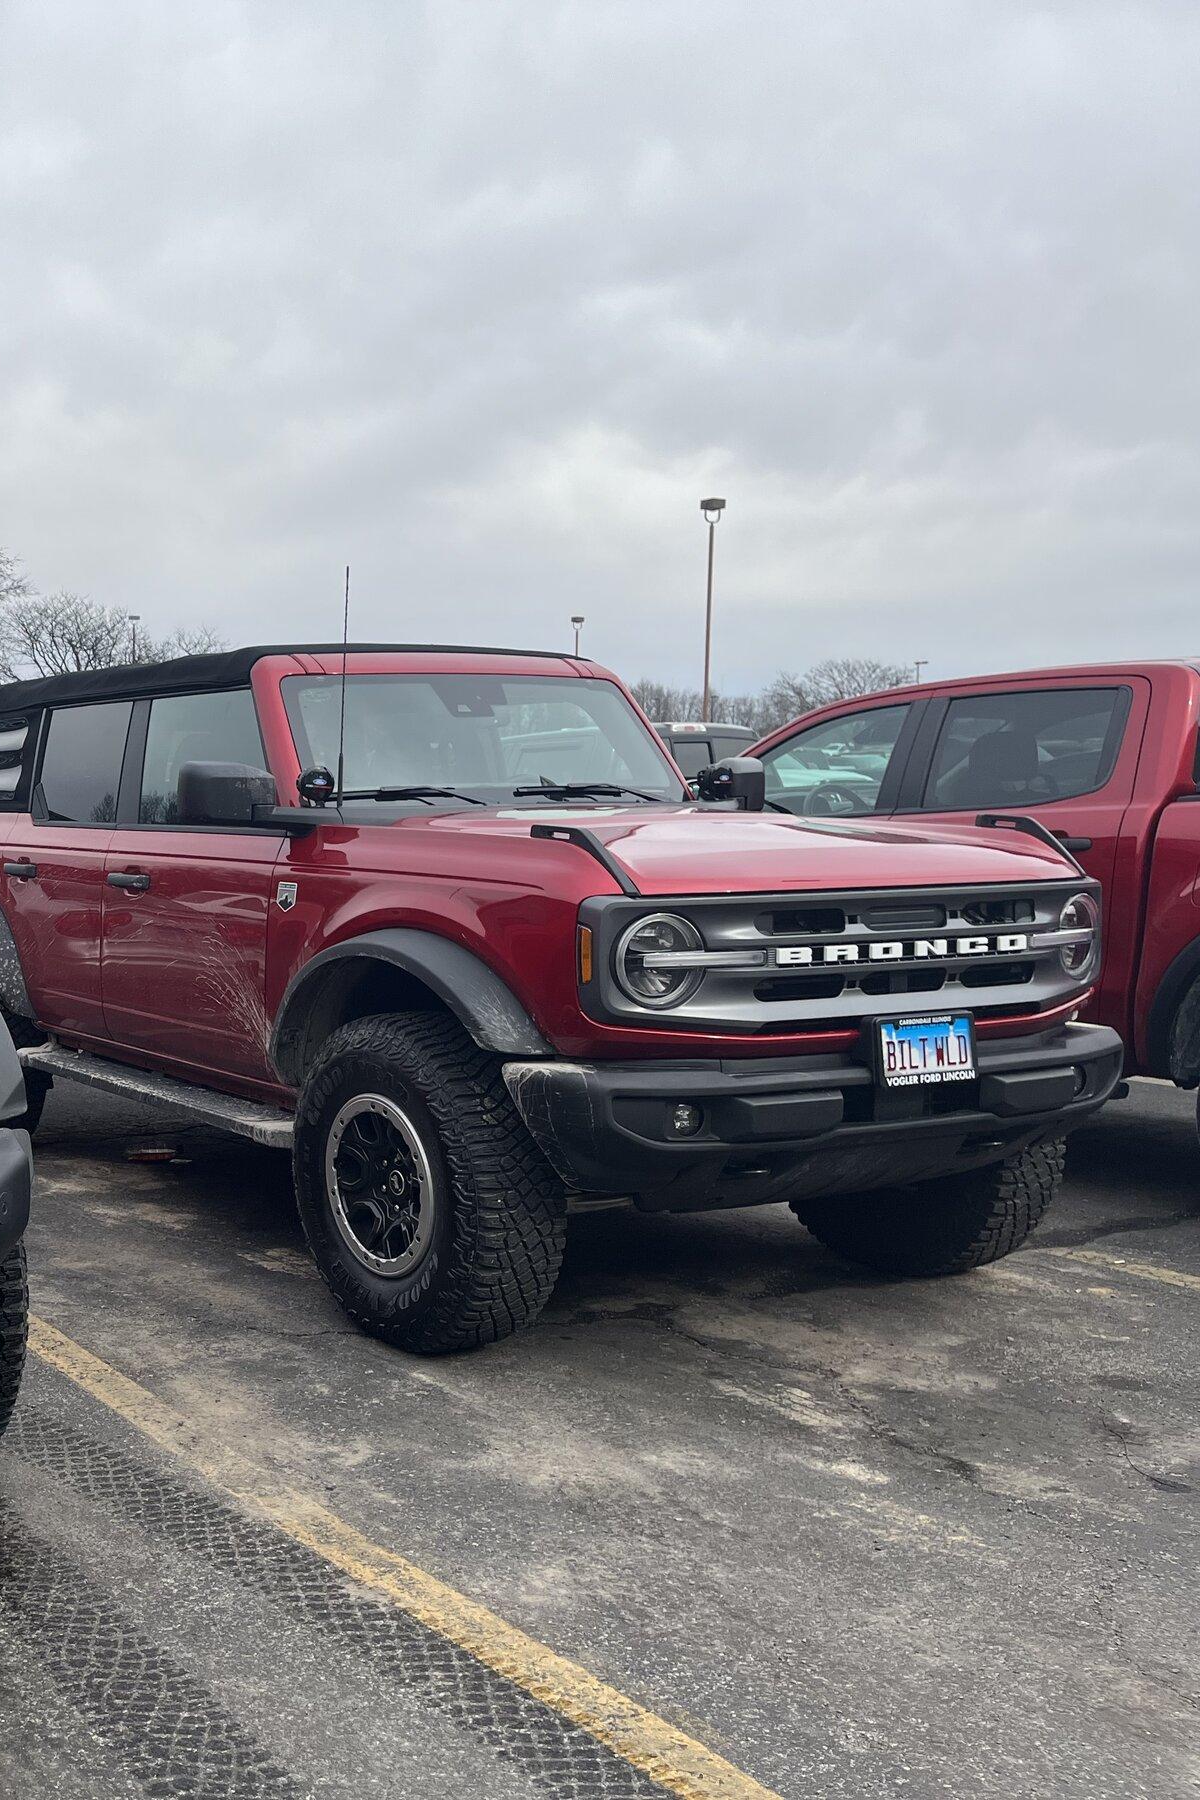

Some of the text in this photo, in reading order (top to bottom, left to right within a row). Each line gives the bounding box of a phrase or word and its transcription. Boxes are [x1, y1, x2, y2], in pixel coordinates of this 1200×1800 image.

[776, 934, 1028, 965] BRONCO
[886, 1070, 976, 1087] VOGLER FORD LINCOLN
